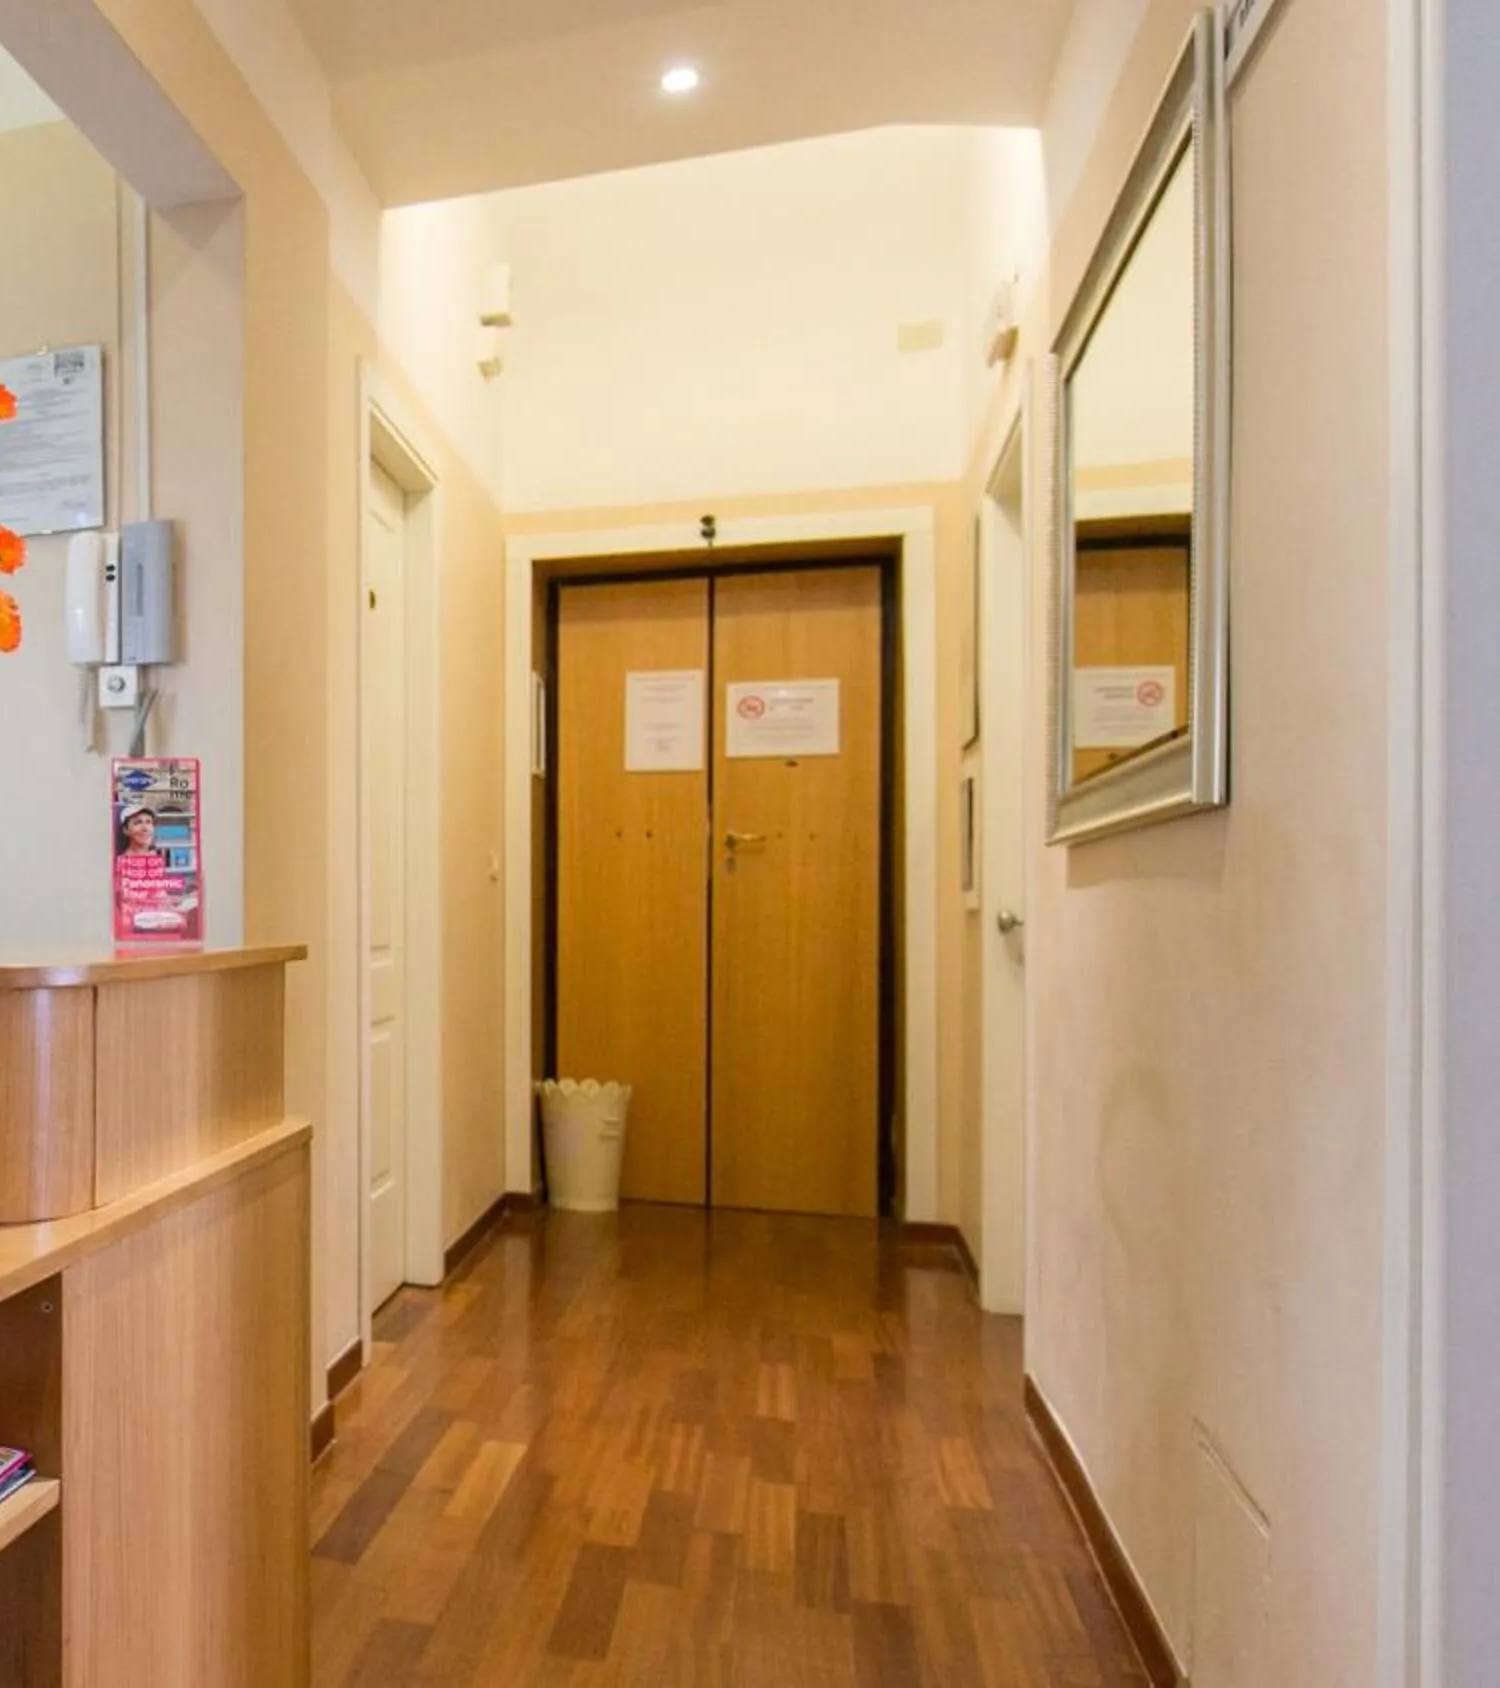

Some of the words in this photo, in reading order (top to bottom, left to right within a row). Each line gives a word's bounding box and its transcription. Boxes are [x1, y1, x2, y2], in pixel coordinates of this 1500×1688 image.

[122, 856, 146, 868] Hop
[122, 868, 146, 879] Hop
[122, 878, 184, 889] Panoramic
[123, 889, 149, 899] Tour
